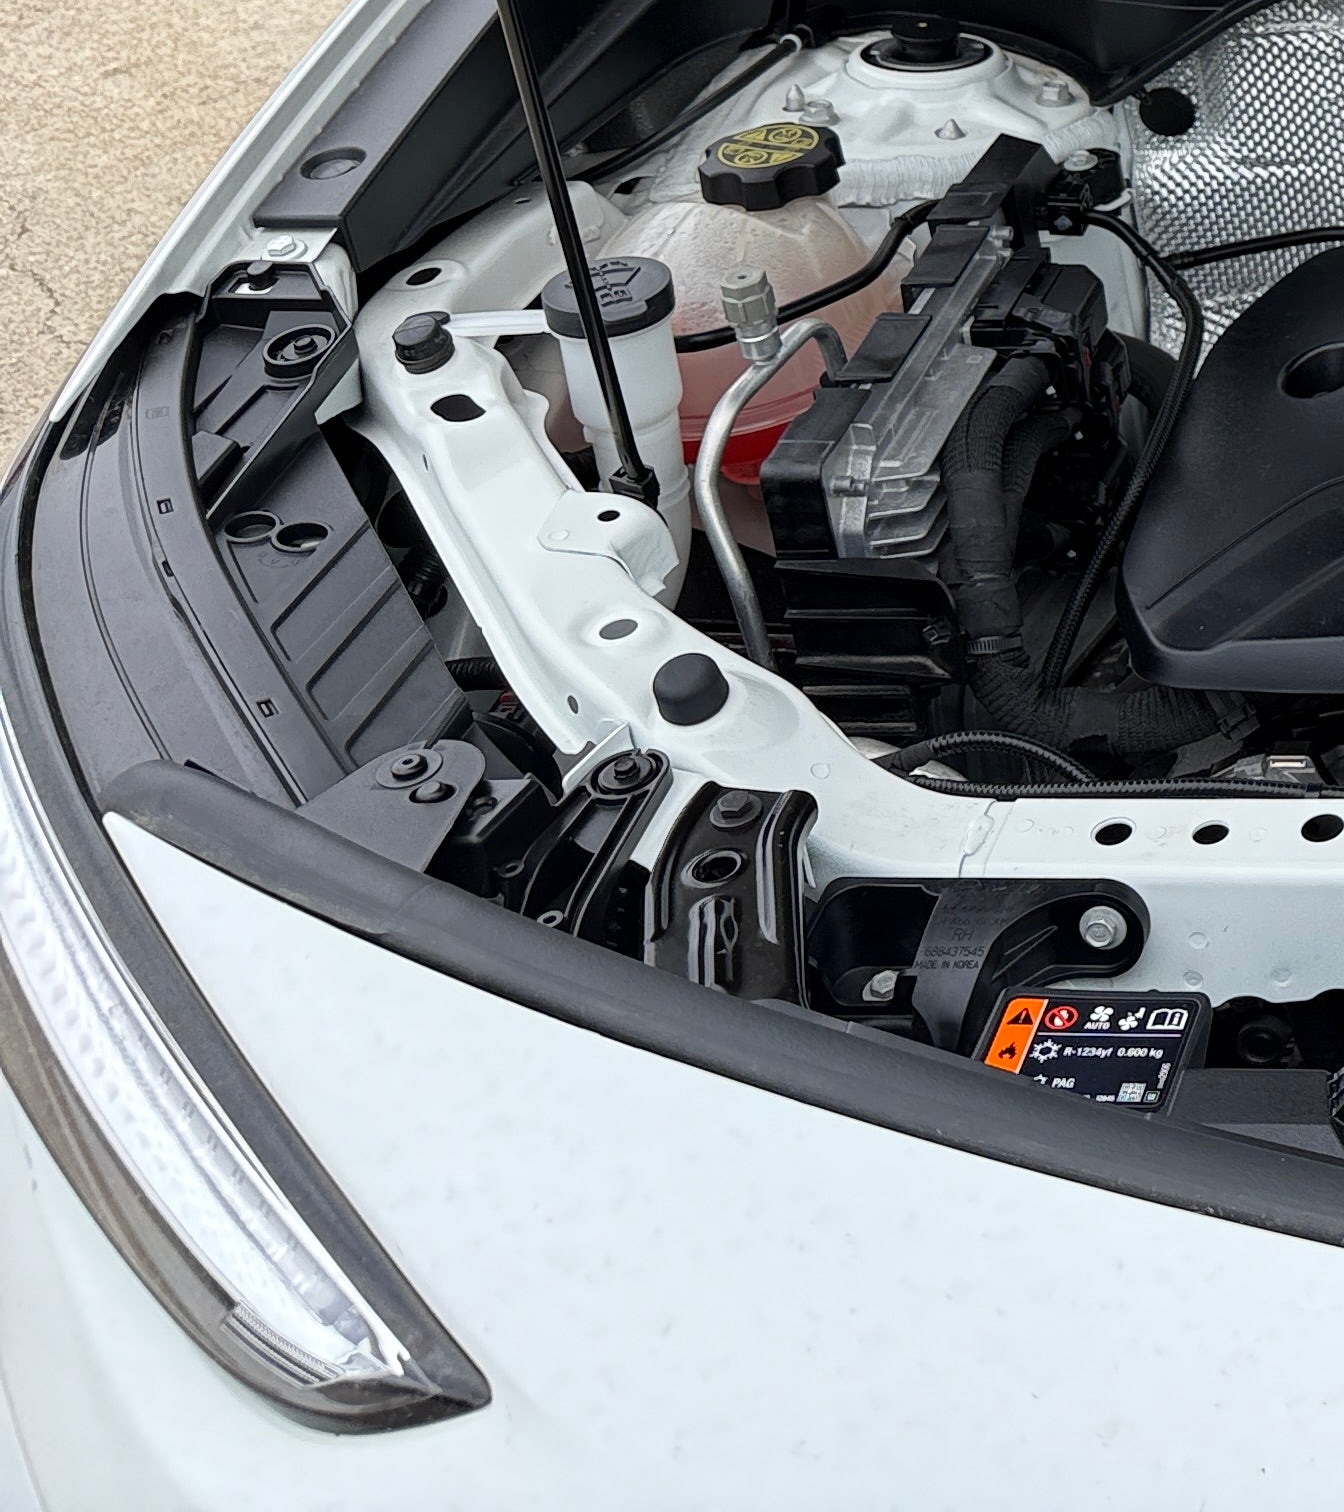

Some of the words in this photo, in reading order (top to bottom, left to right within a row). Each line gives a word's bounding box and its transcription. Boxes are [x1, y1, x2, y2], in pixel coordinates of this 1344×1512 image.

[952, 927, 975, 940] RH
[914, 959, 938, 969] MADE
[942, 960, 950, 969] IN
[953, 960, 979, 969] KOREA
[1084, 1021, 1111, 1030] AUTO
[1063, 1047, 1113, 1058] R-1234yf
[1117, 1047, 1148, 1058] 0.600
[1149, 1047, 1163, 1059] kg
[1051, 1077, 1075, 1088] PAG
